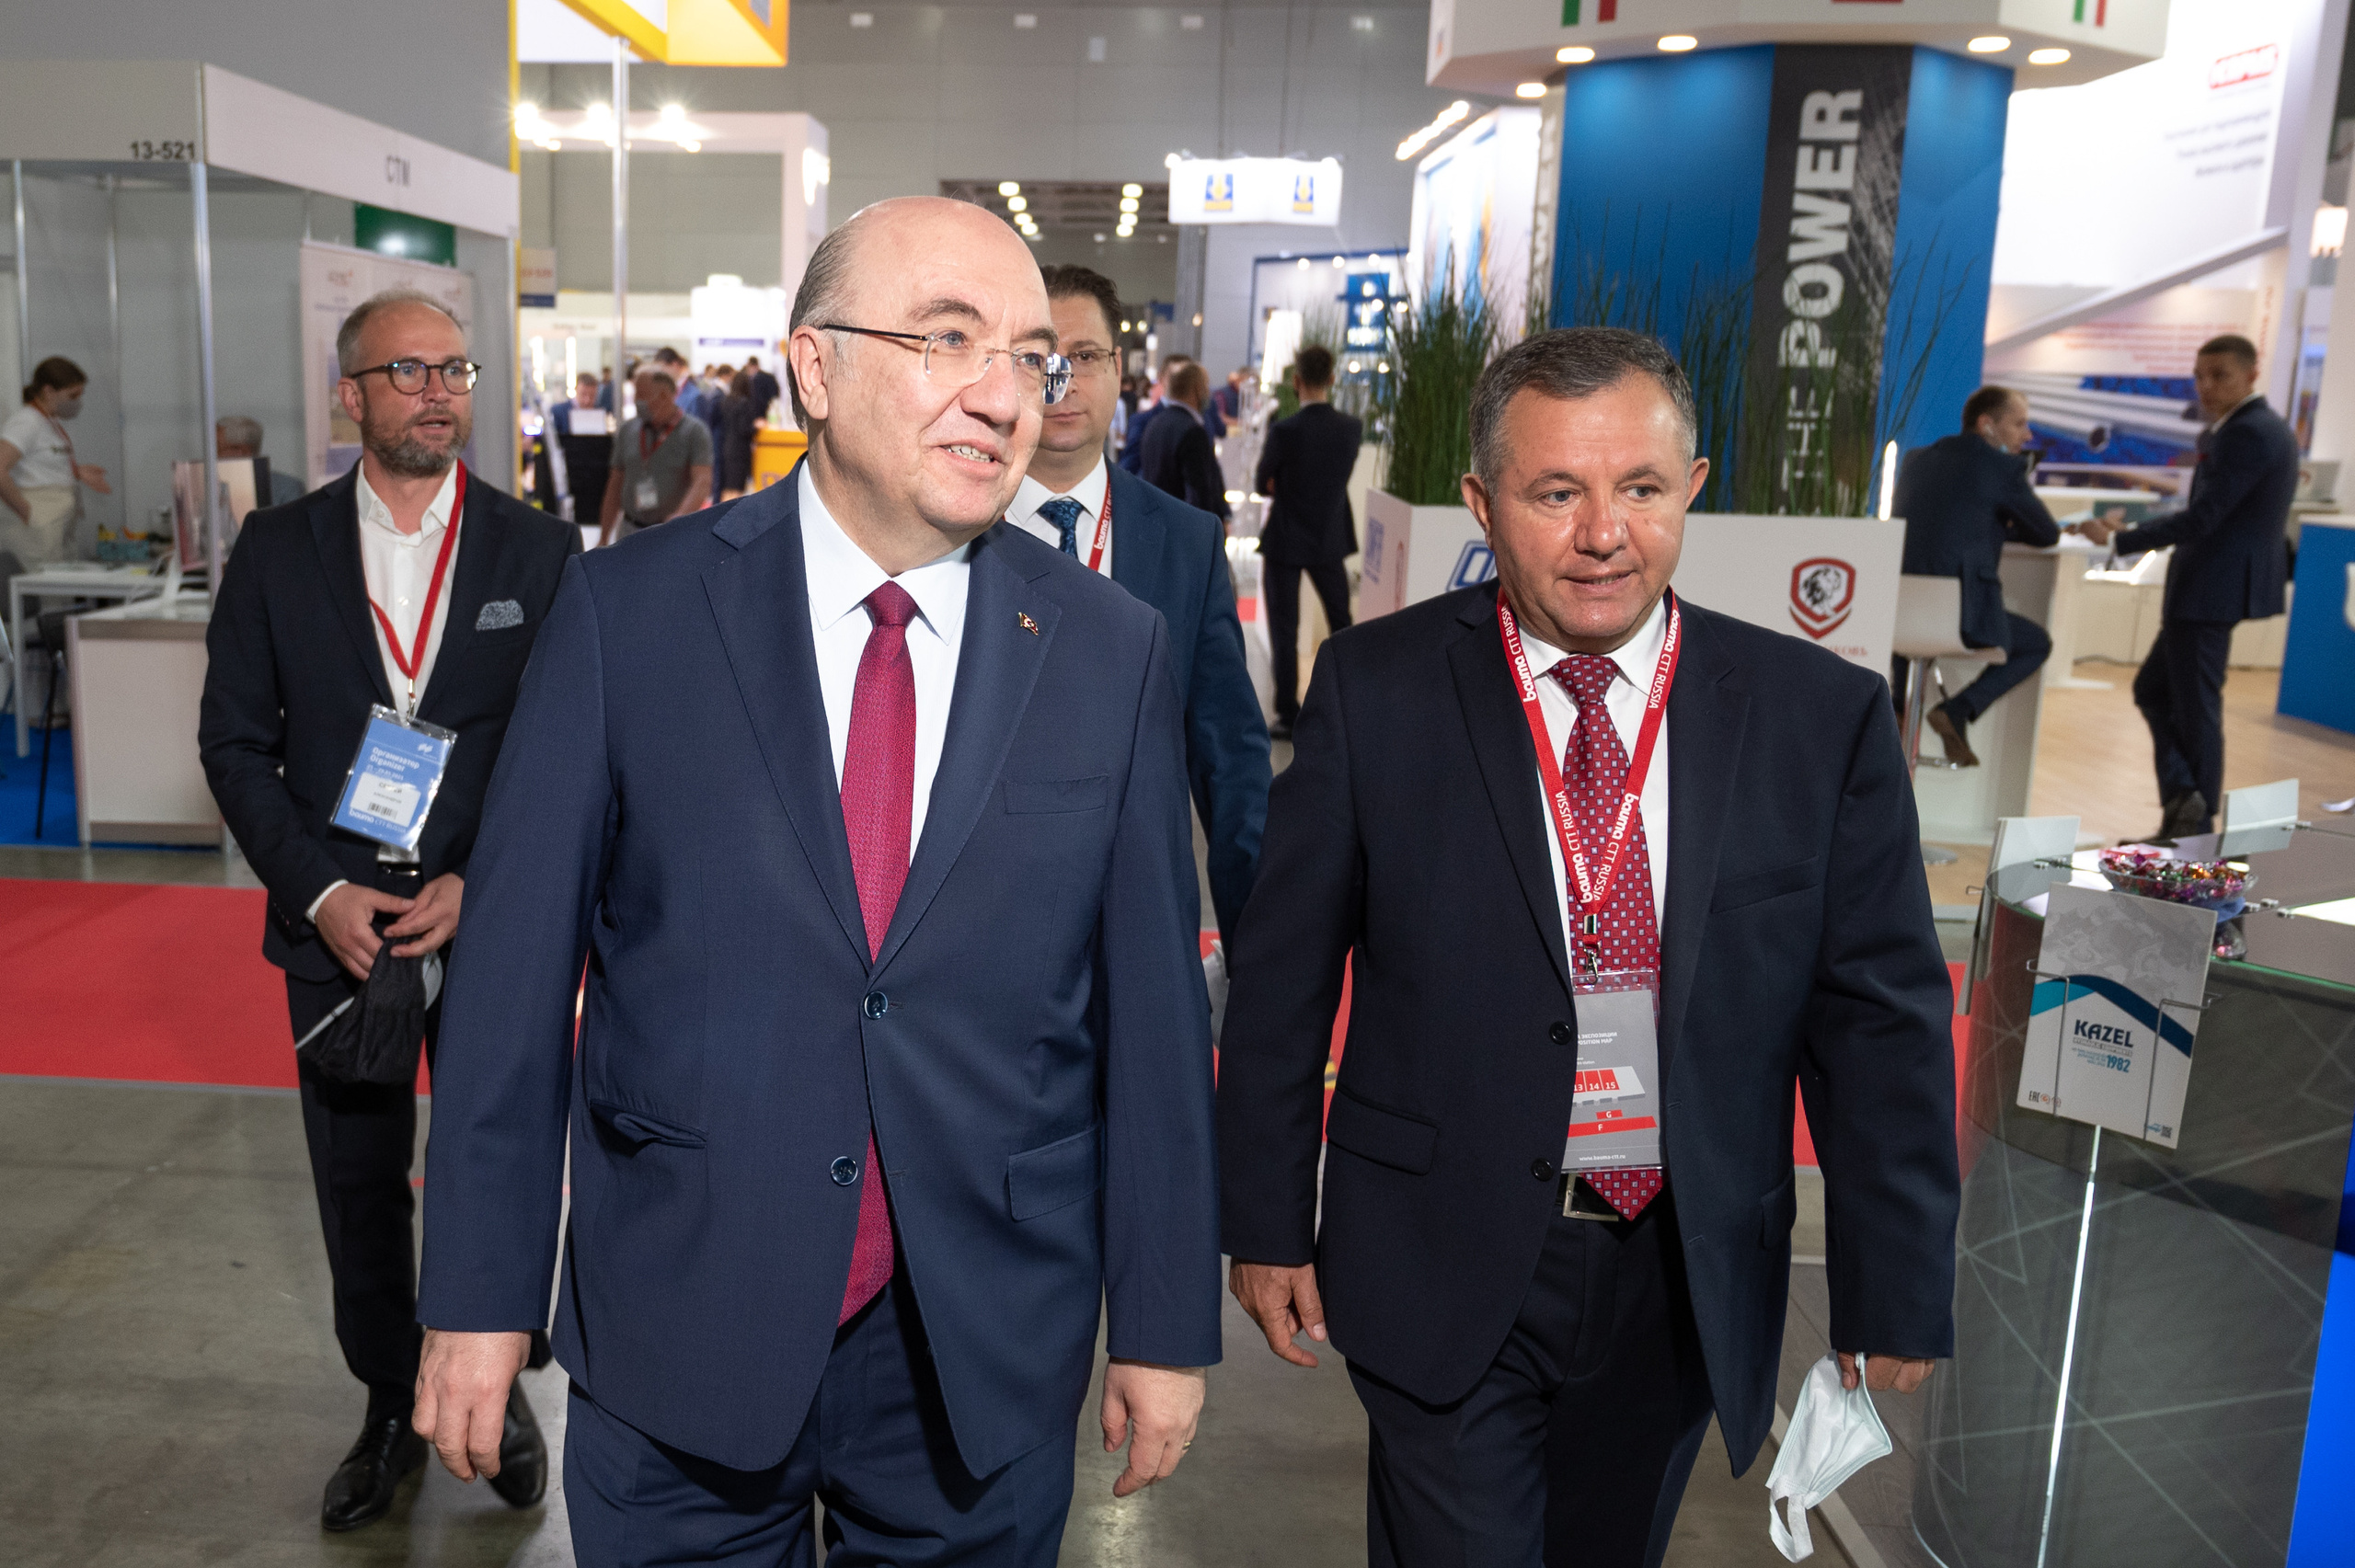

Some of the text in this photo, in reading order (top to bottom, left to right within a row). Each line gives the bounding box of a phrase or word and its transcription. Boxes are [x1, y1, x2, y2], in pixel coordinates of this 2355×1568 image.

[131, 140, 195, 160] 13-521
[1780, 89, 1864, 368] POWER
[1094, 520, 1109, 550] bauma
[1500, 603, 1537, 703] bauma CTT RUSSIA
[1648, 609, 1681, 709] bauma CTT RUSSIA
[369, 754, 406, 773] Organizer
[372, 747, 420, 770] Организатор
[350, 808, 374, 824] bauma
[1555, 791, 1593, 903] bauma CTT RUSSIA
[1592, 793, 1639, 901] bauma CTT RUSSIA
[2074, 1019, 2134, 1048] KAZEL
[2106, 1054, 2131, 1074] 1982
[1589, 1082, 1600, 1091] 14
[1605, 1082, 1616, 1090] 15
